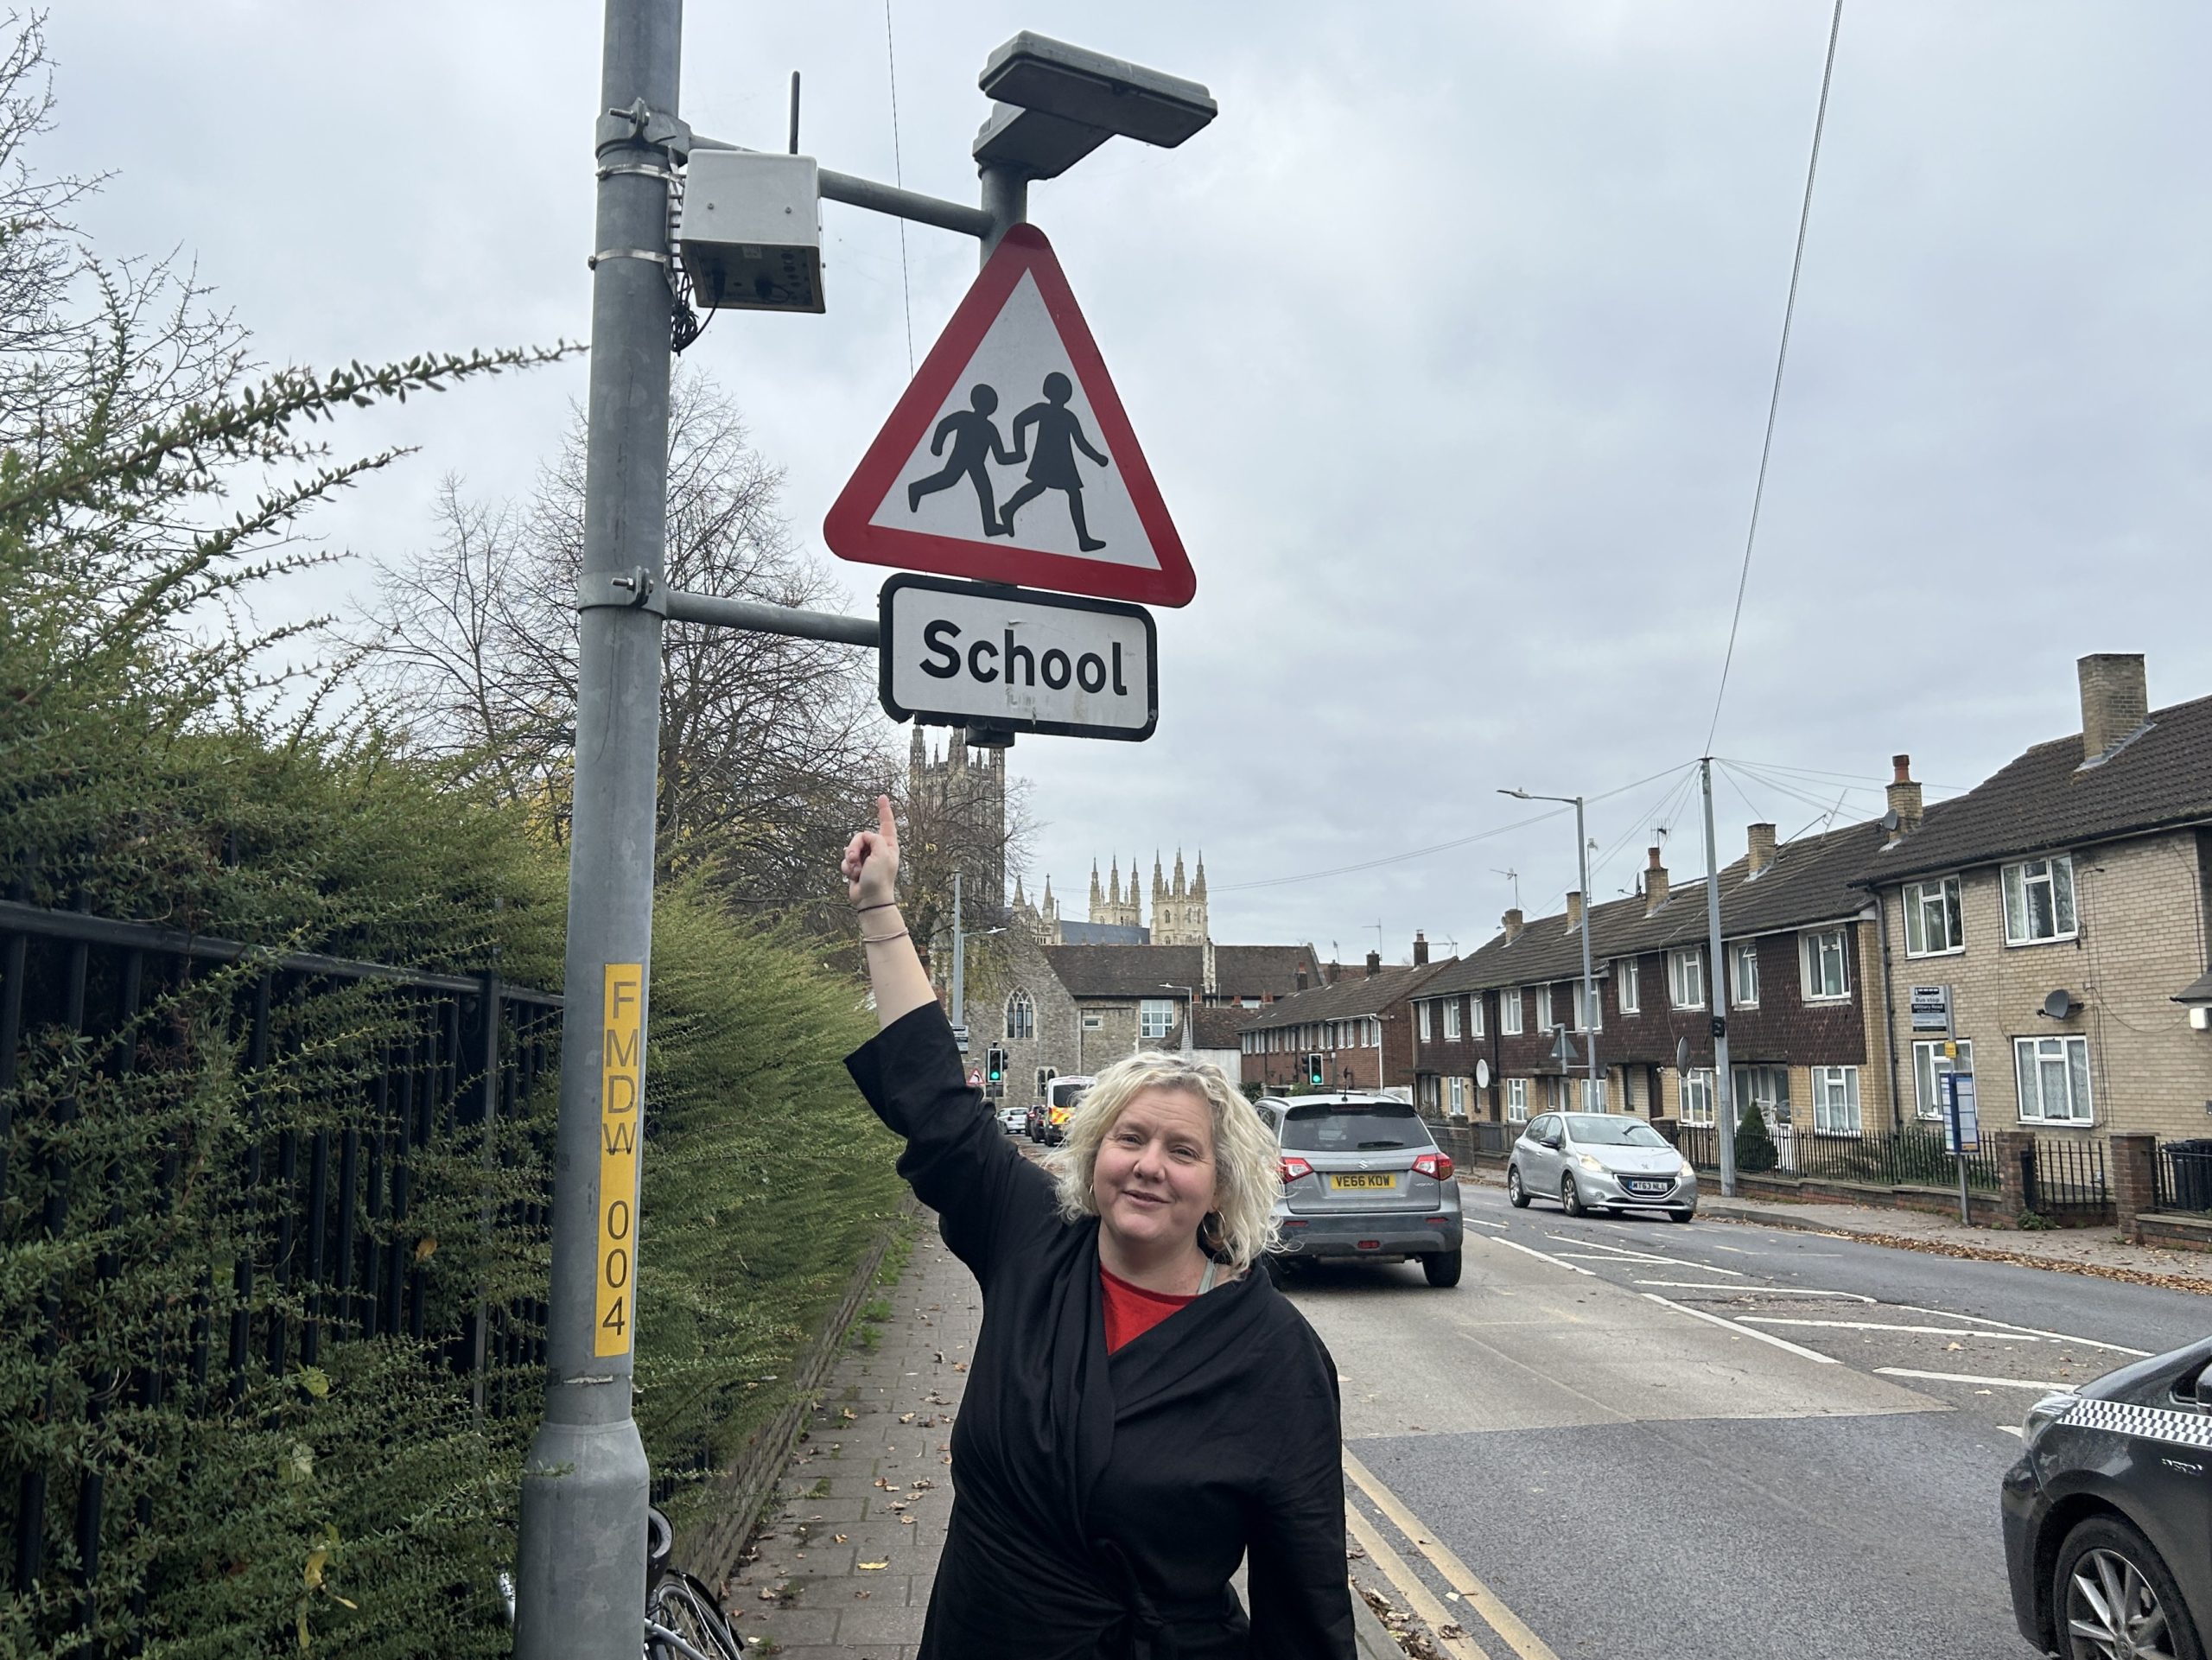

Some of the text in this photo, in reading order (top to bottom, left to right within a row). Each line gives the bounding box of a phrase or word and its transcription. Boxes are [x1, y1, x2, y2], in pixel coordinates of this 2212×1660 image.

[918, 619, 1128, 696] School
[602, 981, 639, 1337] FMDW 004
[1335, 1174, 1389, 1187] VE66 KOW
